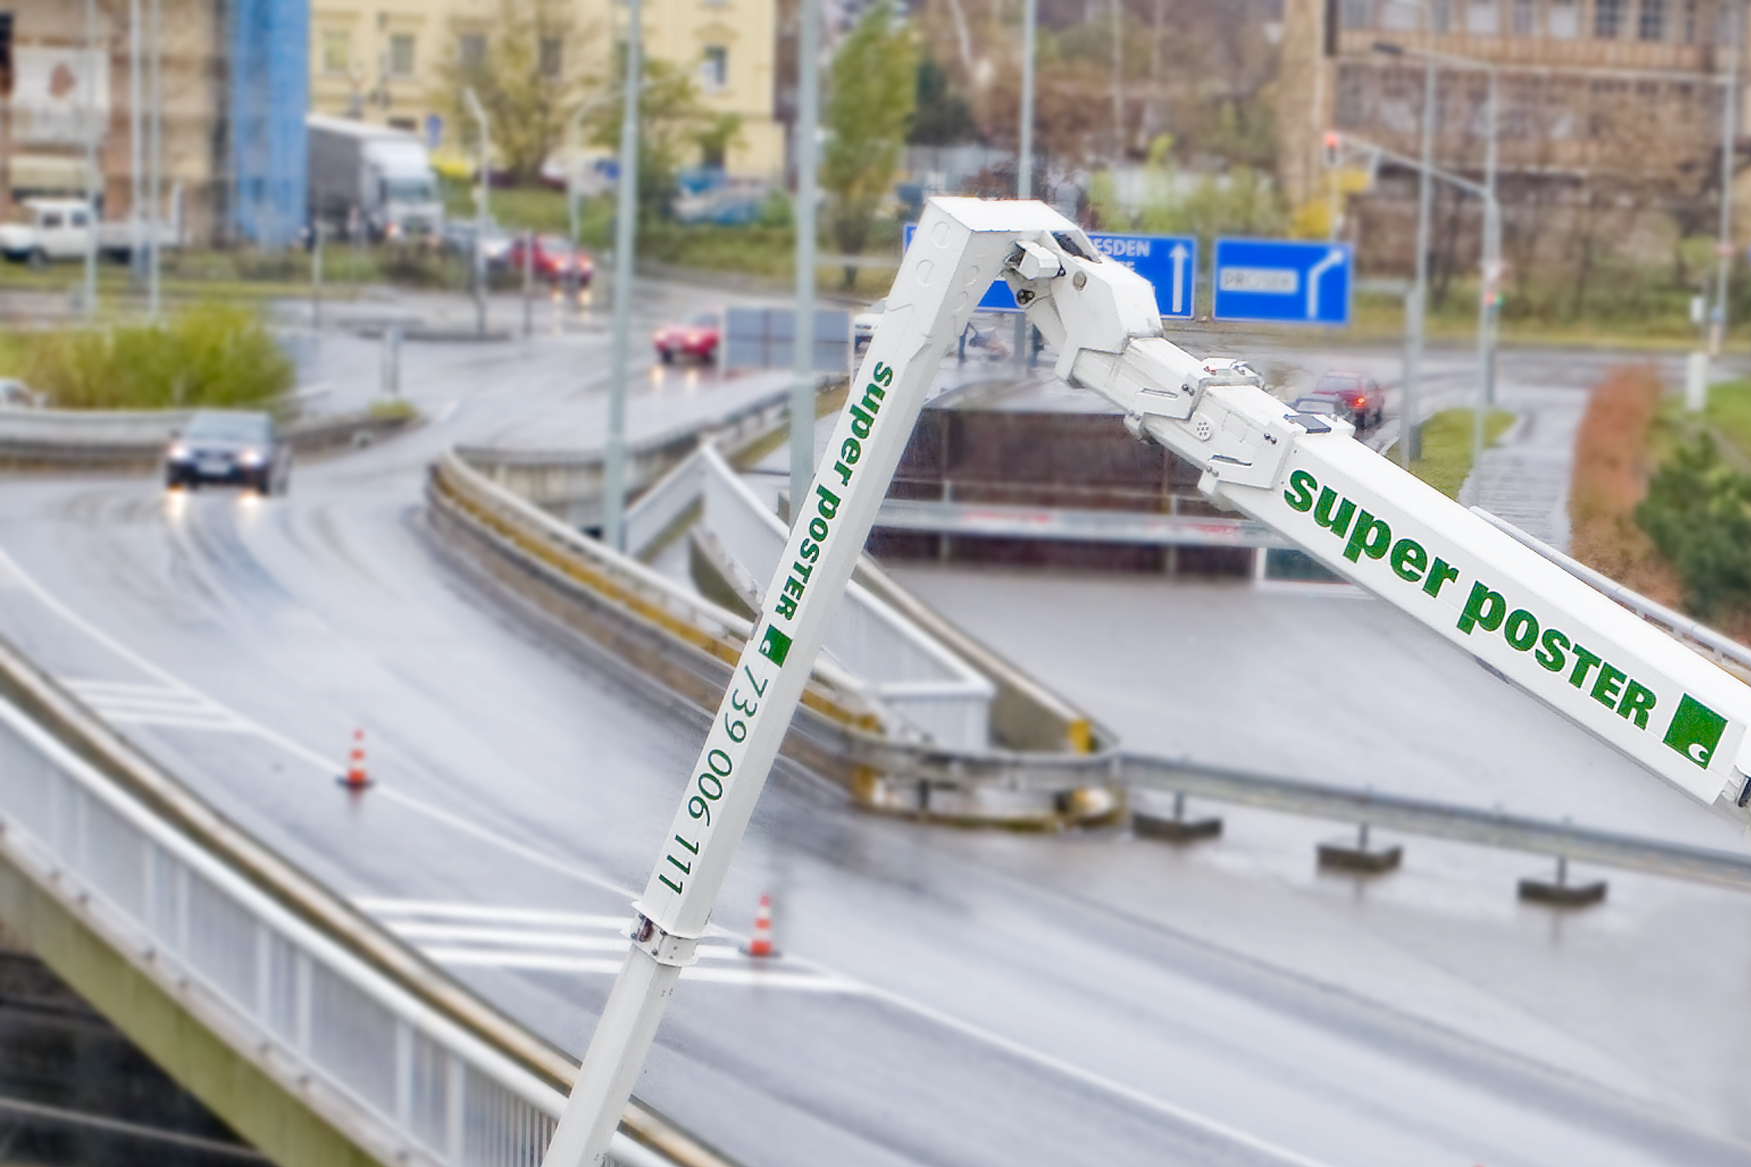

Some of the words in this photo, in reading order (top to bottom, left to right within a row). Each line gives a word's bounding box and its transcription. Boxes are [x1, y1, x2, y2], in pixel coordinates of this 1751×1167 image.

[1093, 237, 1151, 258] ESDEN
[834, 360, 894, 487] super
[1284, 469, 1460, 598] super
[725, 664, 769, 745] 739
[688, 748, 734, 827] 006
[658, 832, 700, 895] 111
